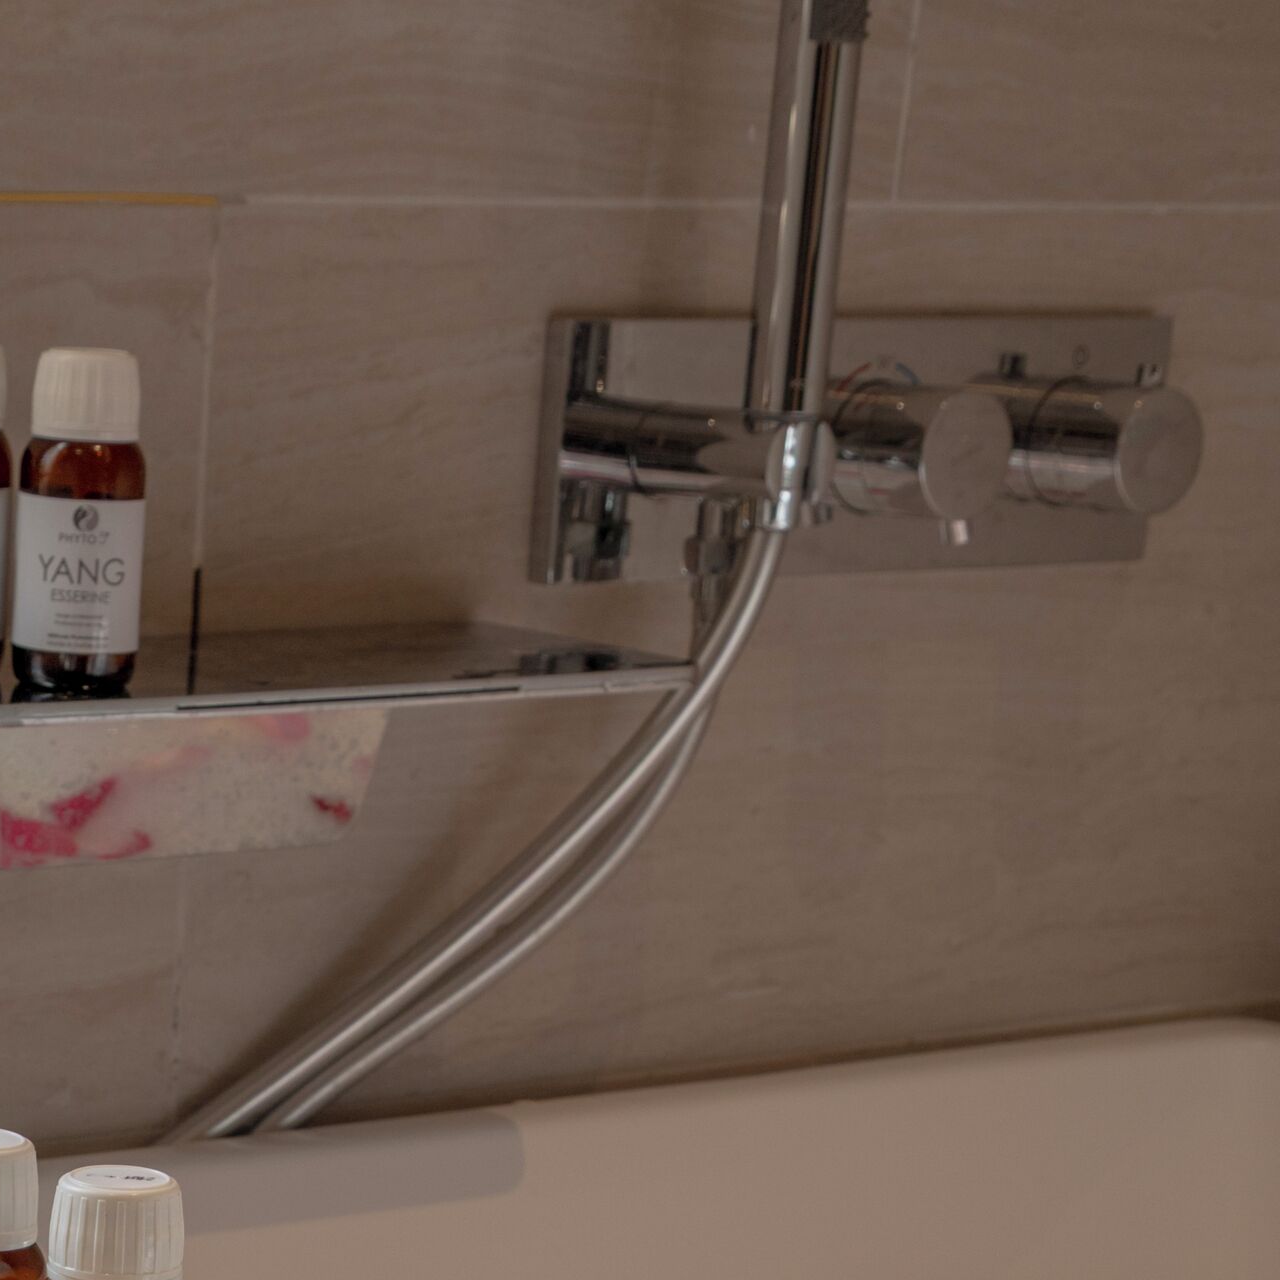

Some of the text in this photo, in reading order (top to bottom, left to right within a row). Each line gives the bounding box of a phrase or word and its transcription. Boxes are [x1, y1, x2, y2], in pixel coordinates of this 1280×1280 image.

[59, 532, 97, 544] PHYTO
[39, 554, 125, 586] YANG
[51, 588, 111, 605] ESSERINE
